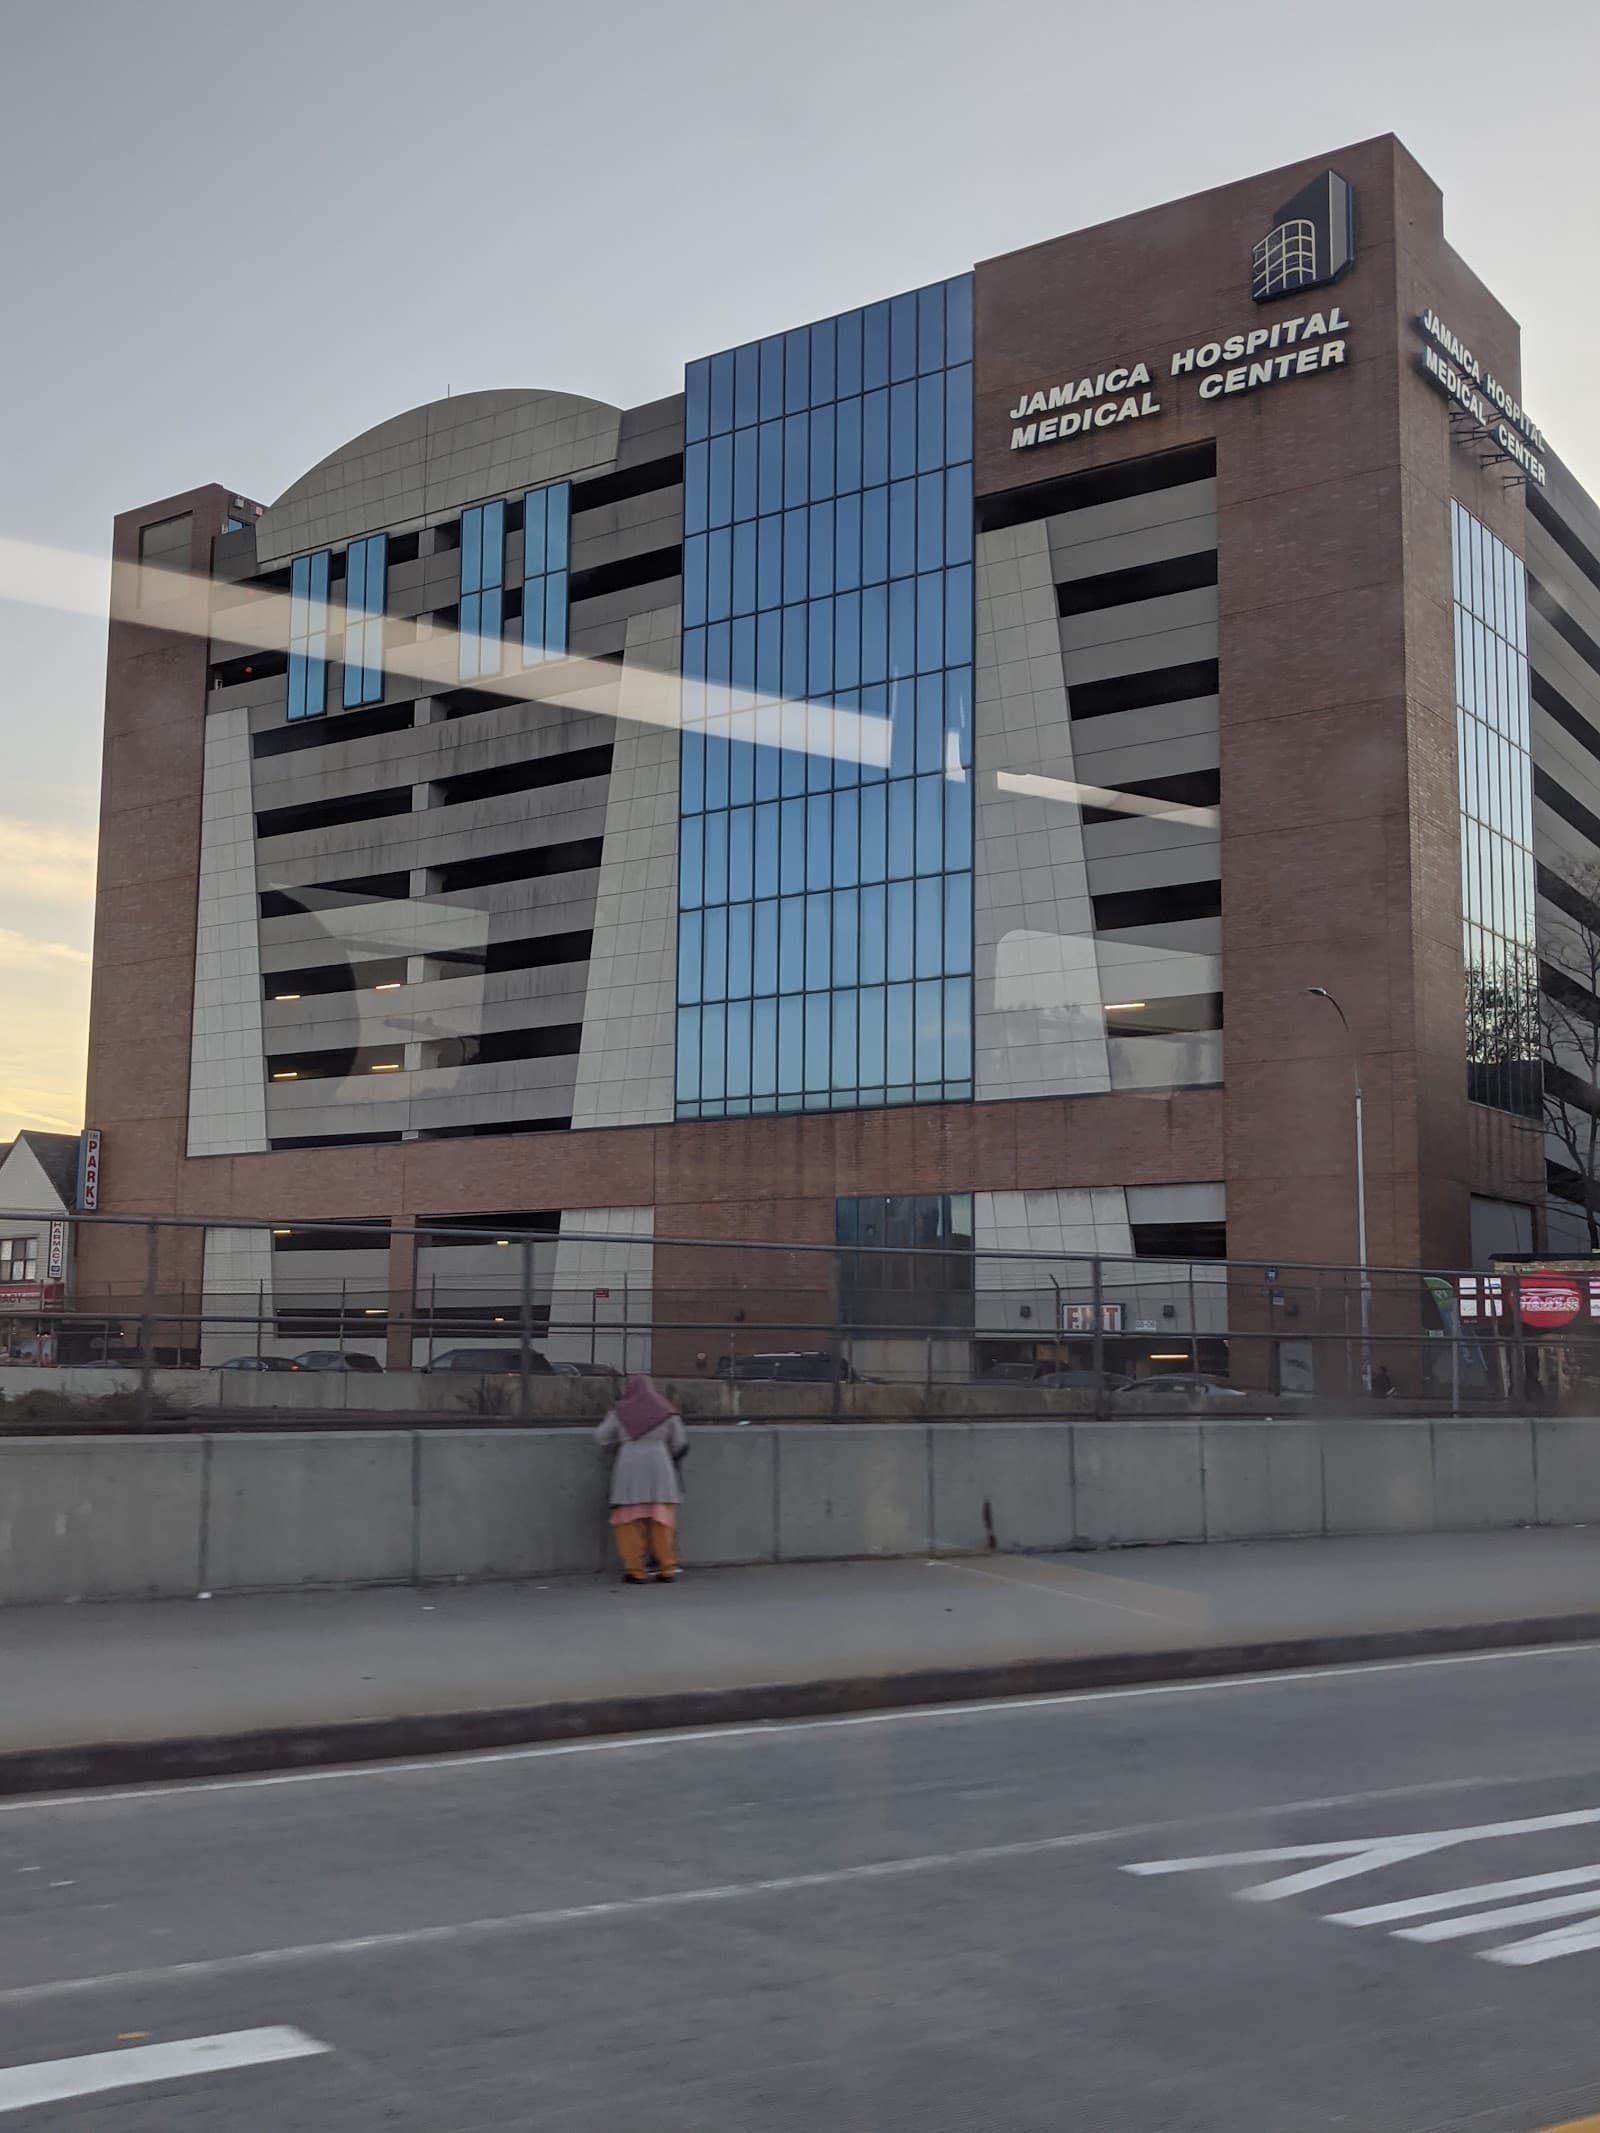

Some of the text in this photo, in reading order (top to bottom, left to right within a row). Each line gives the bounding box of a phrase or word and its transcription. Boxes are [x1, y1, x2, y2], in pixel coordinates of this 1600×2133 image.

[1009, 307, 1350, 420] JAMAICA HOSPITAL
[1009, 340, 1346, 451] MEDICAL CENTER
[1423, 308, 1546, 453] JAMAICA HOSPITAL
[1425, 345, 1546, 487] MEDICAL CENTER
[86, 1140, 98, 1199] PARK
[52, 1221, 62, 1264] HARMACY
[1066, 1307, 1119, 1331] EXT
